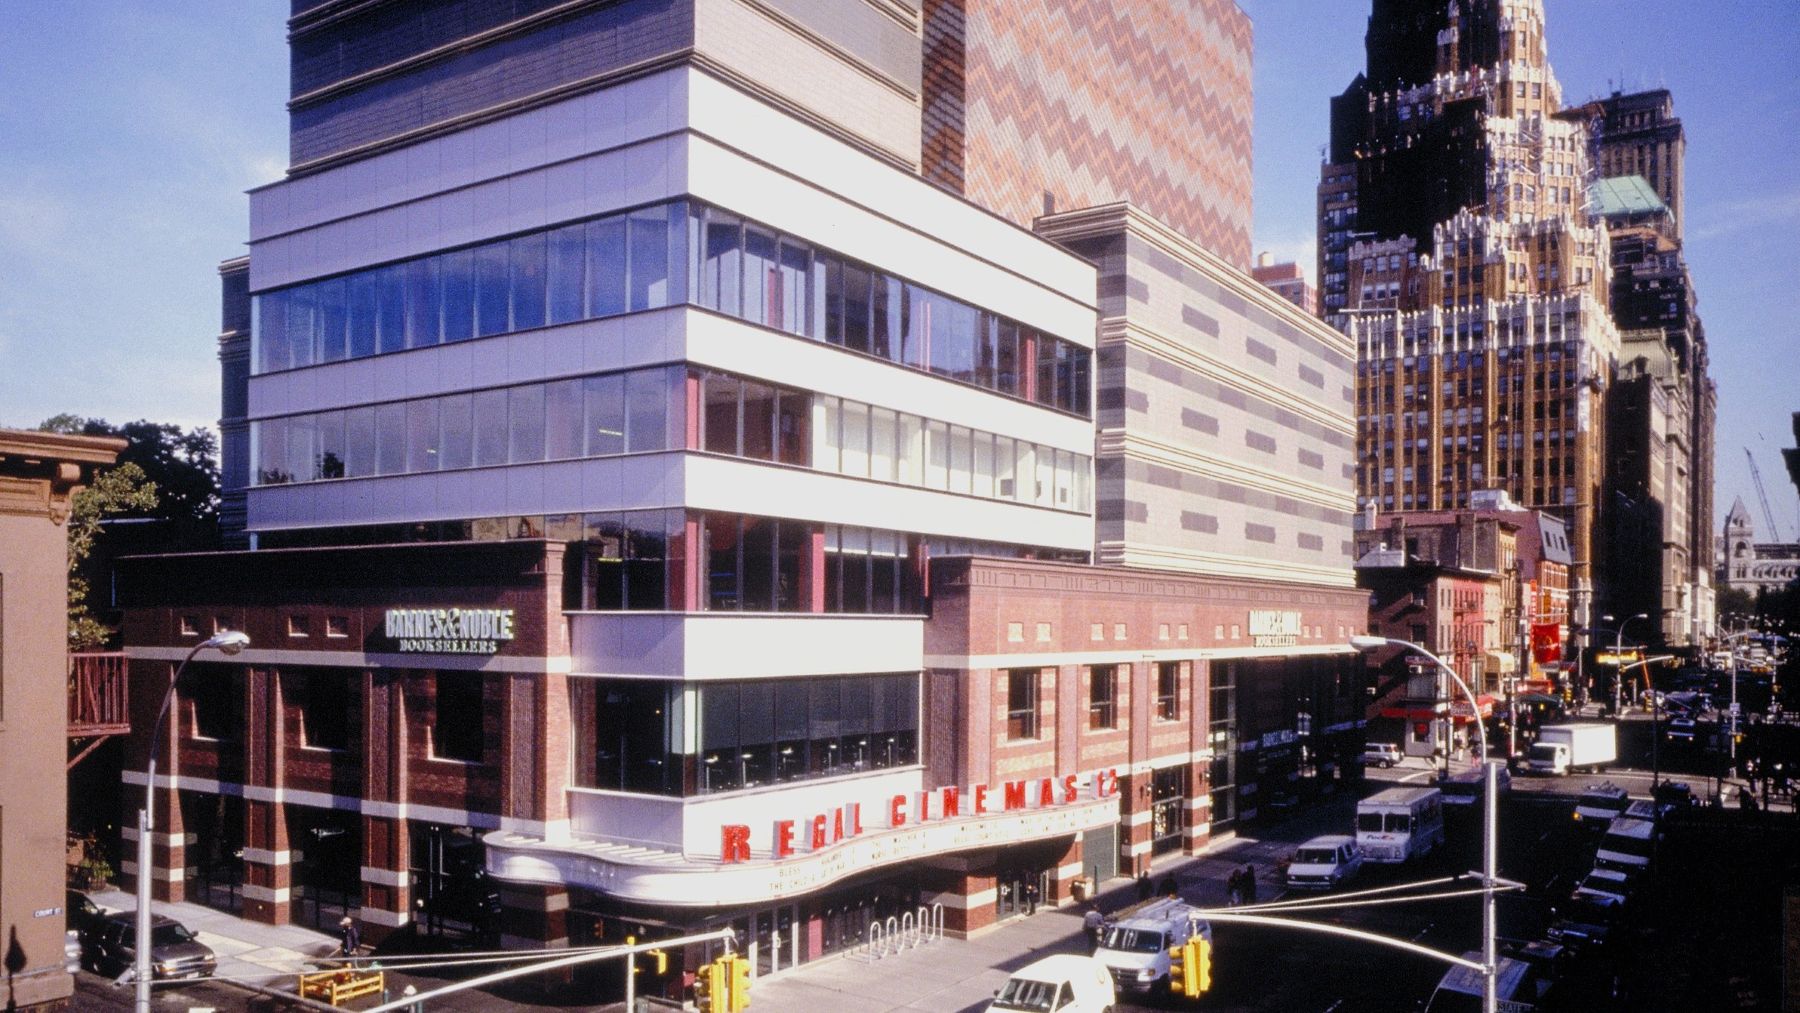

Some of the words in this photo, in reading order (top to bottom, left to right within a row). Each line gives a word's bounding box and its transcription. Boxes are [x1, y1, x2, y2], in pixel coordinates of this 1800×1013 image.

[400, 640, 497, 653] BOOKSELLERS
[721, 802, 863, 865] REGAL
[890, 776, 1077, 828] CINEMAS
[1095, 768, 1119, 798] 12
